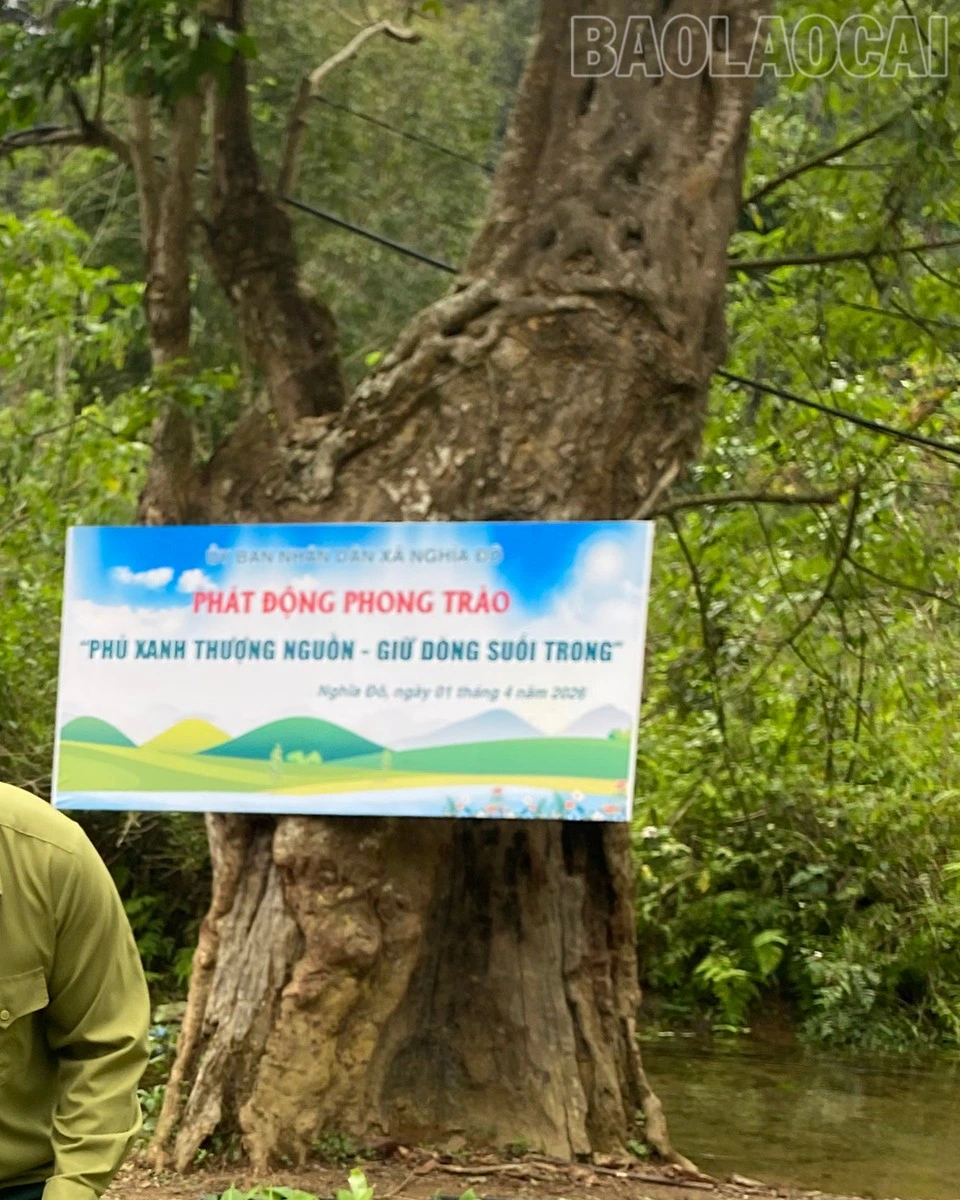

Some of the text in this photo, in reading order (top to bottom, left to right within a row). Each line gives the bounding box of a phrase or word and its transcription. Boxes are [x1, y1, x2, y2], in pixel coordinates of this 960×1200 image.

[236, 548, 273, 564] BAN
[193, 586, 254, 614] PHÁT
[262, 585, 336, 618] ĐỘNG
[343, 591, 434, 614] PHONG
[135, 640, 186, 660] XANH
[194, 637, 276, 665] THƯỢNG
[435, 686, 452, 699] 01
[504, 687, 513, 699] 4
